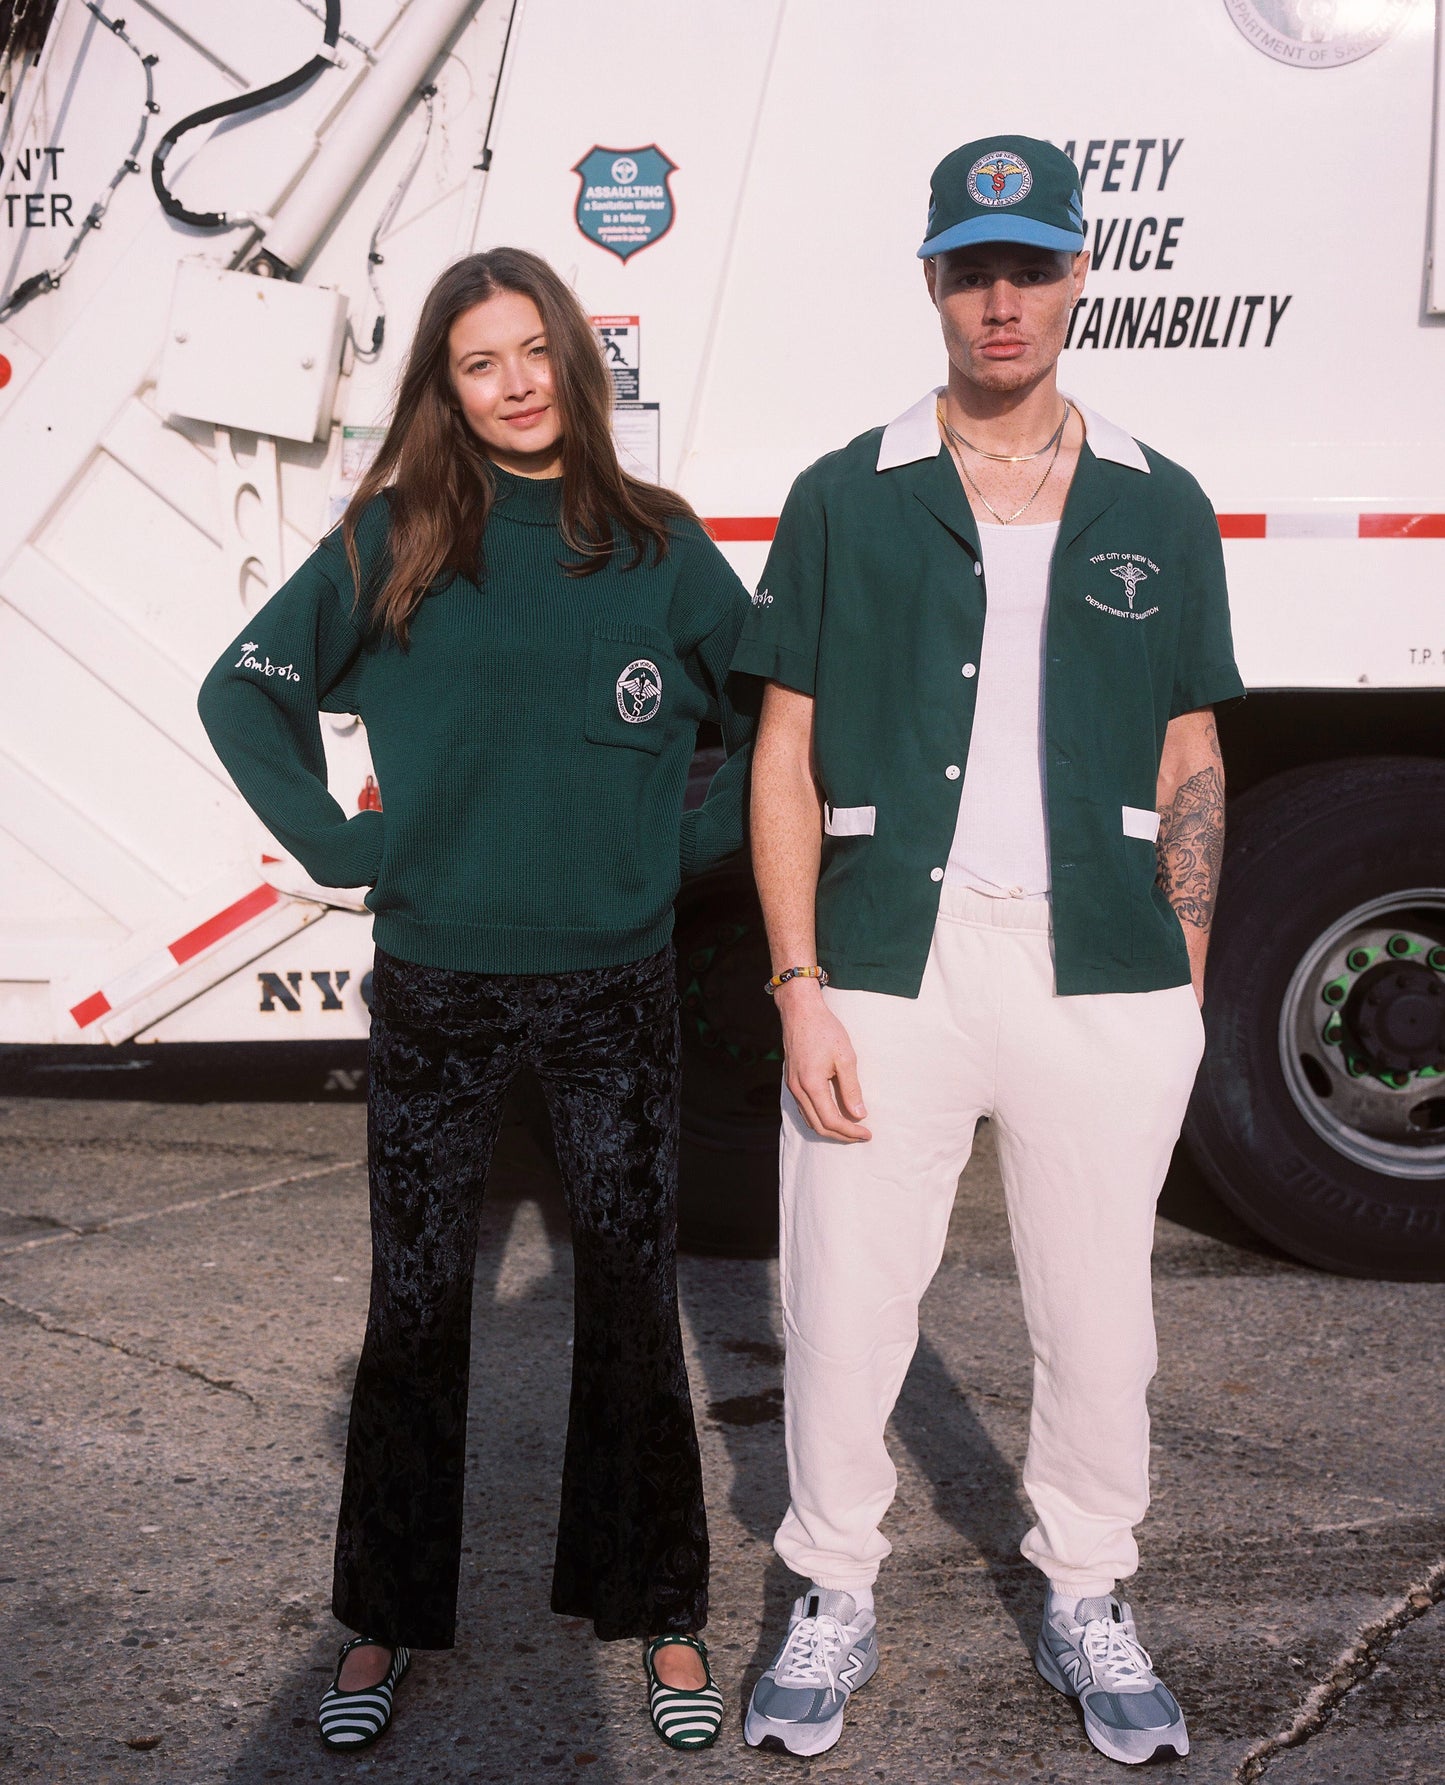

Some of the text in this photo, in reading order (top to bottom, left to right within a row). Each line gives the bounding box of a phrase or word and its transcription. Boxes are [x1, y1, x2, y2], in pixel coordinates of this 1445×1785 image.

[1308, 50, 1328, 62] OF
[586, 185, 664, 199] ASSAULTING
[1083, 217, 1184, 271] VICE
[1089, 554, 1106, 564] THE
[1106, 552, 1120, 560] CITY
[1131, 554, 1147, 563] NEW
[1085, 594, 1130, 618] DEPARTMENT
